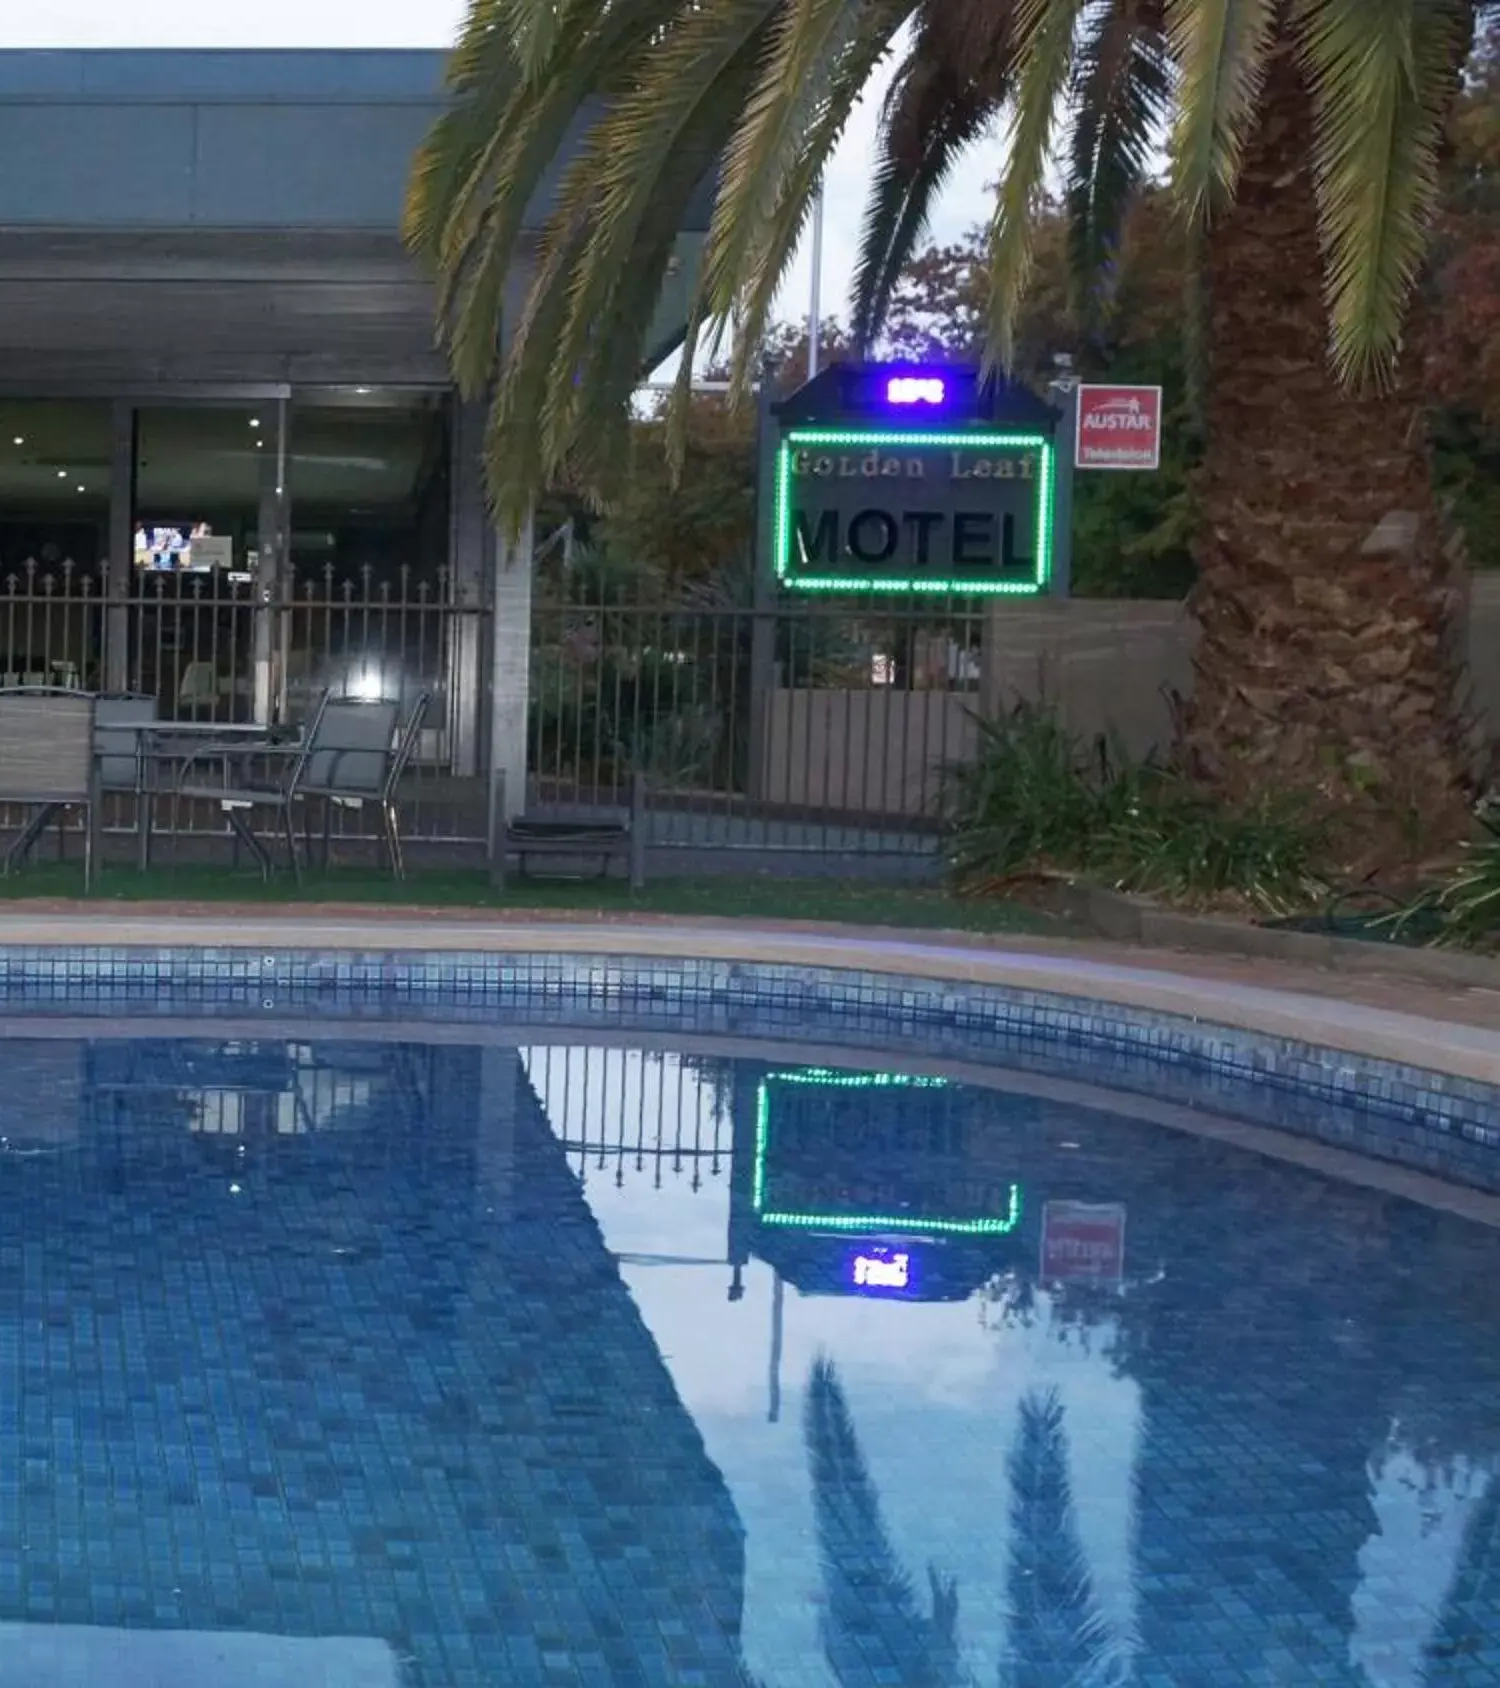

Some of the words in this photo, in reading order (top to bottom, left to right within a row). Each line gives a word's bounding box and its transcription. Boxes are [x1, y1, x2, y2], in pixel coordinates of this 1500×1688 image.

[1082, 411, 1152, 431] AUSTAR
[951, 450, 1035, 479] Leaf
[791, 508, 1035, 566] MOTEL
